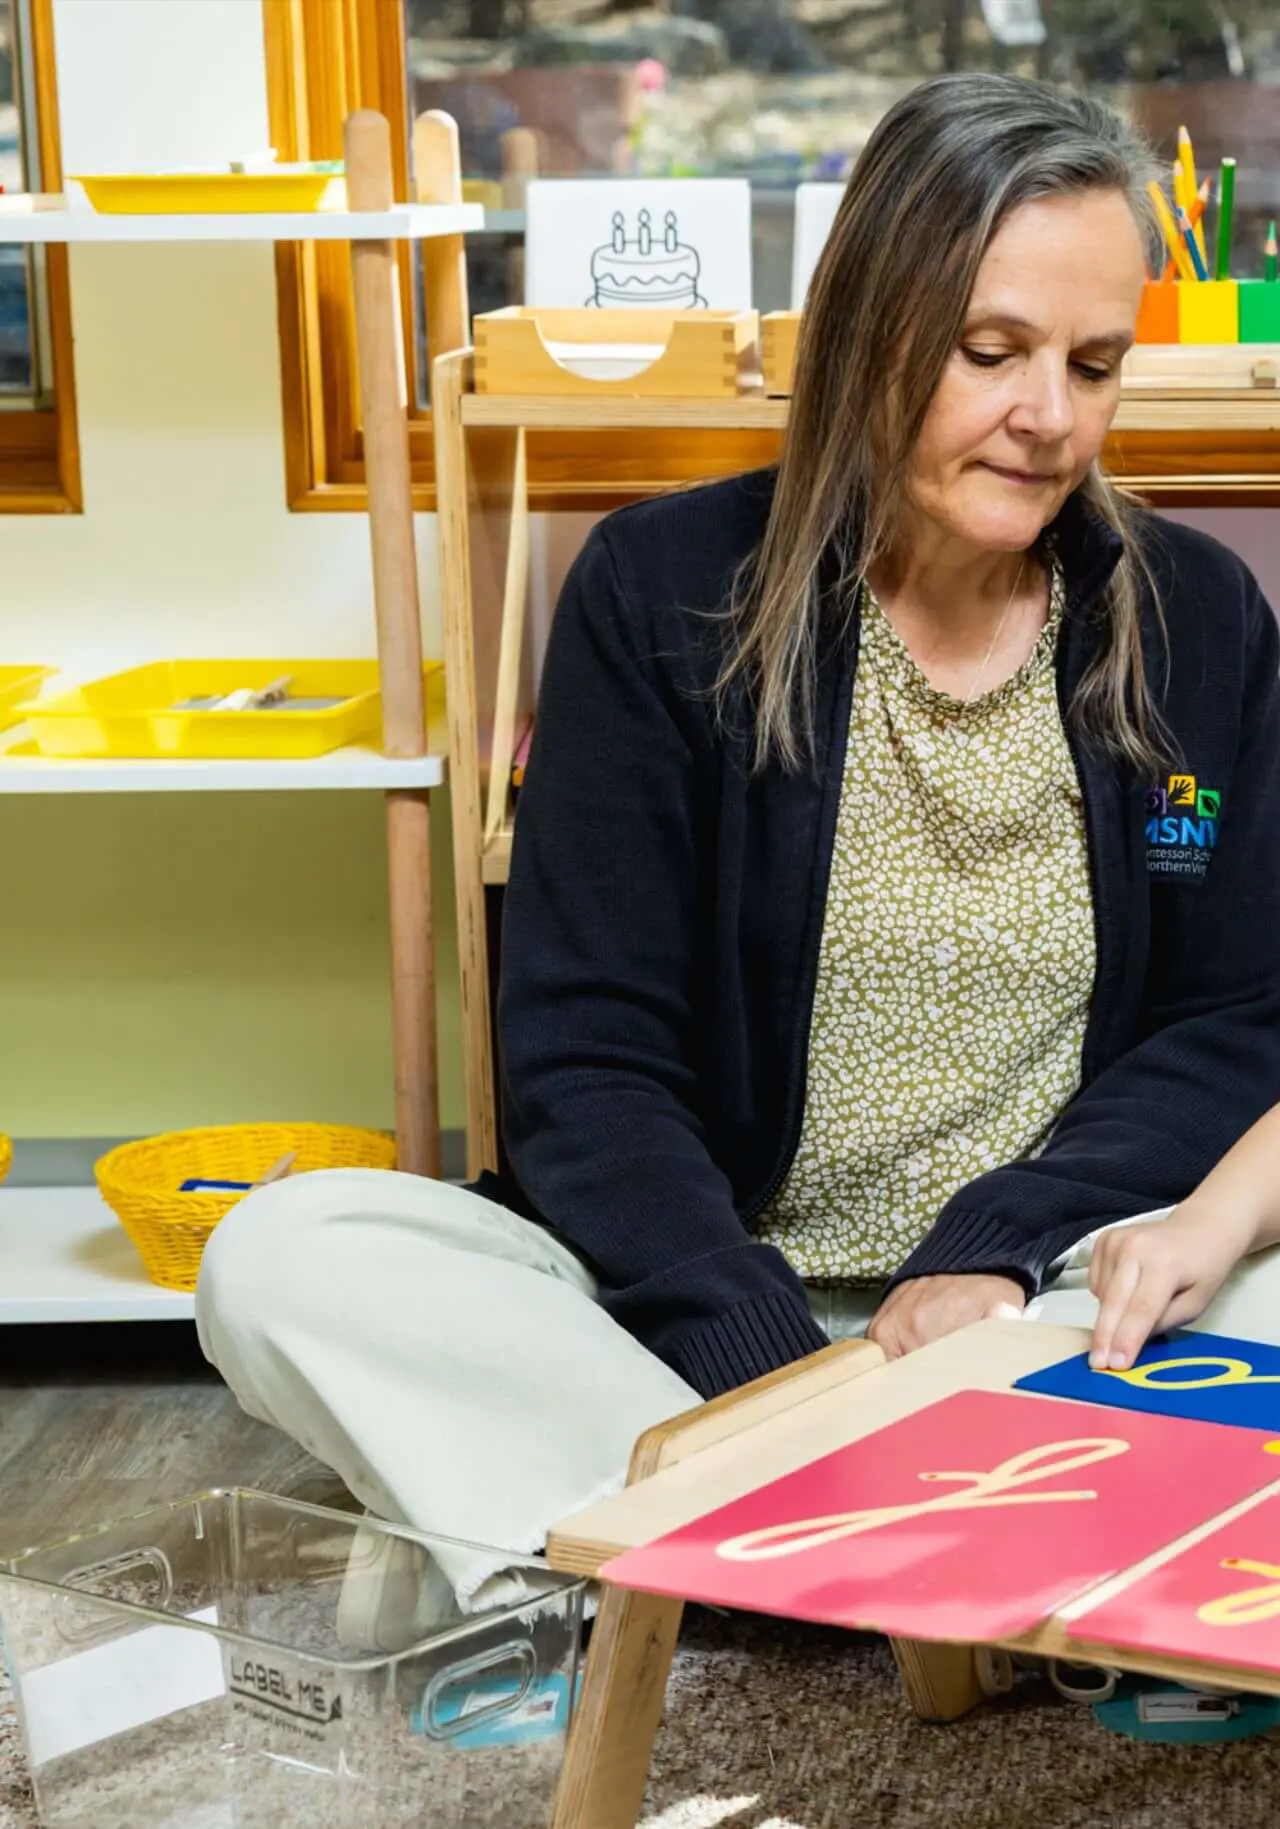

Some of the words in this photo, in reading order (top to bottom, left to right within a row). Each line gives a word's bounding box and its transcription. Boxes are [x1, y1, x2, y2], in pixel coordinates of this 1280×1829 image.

[1146, 848, 1192, 860] ntessori
[1146, 859, 1191, 873] orthern
[230, 1655, 293, 1701] LABEL
[297, 1678, 326, 1713] ME
